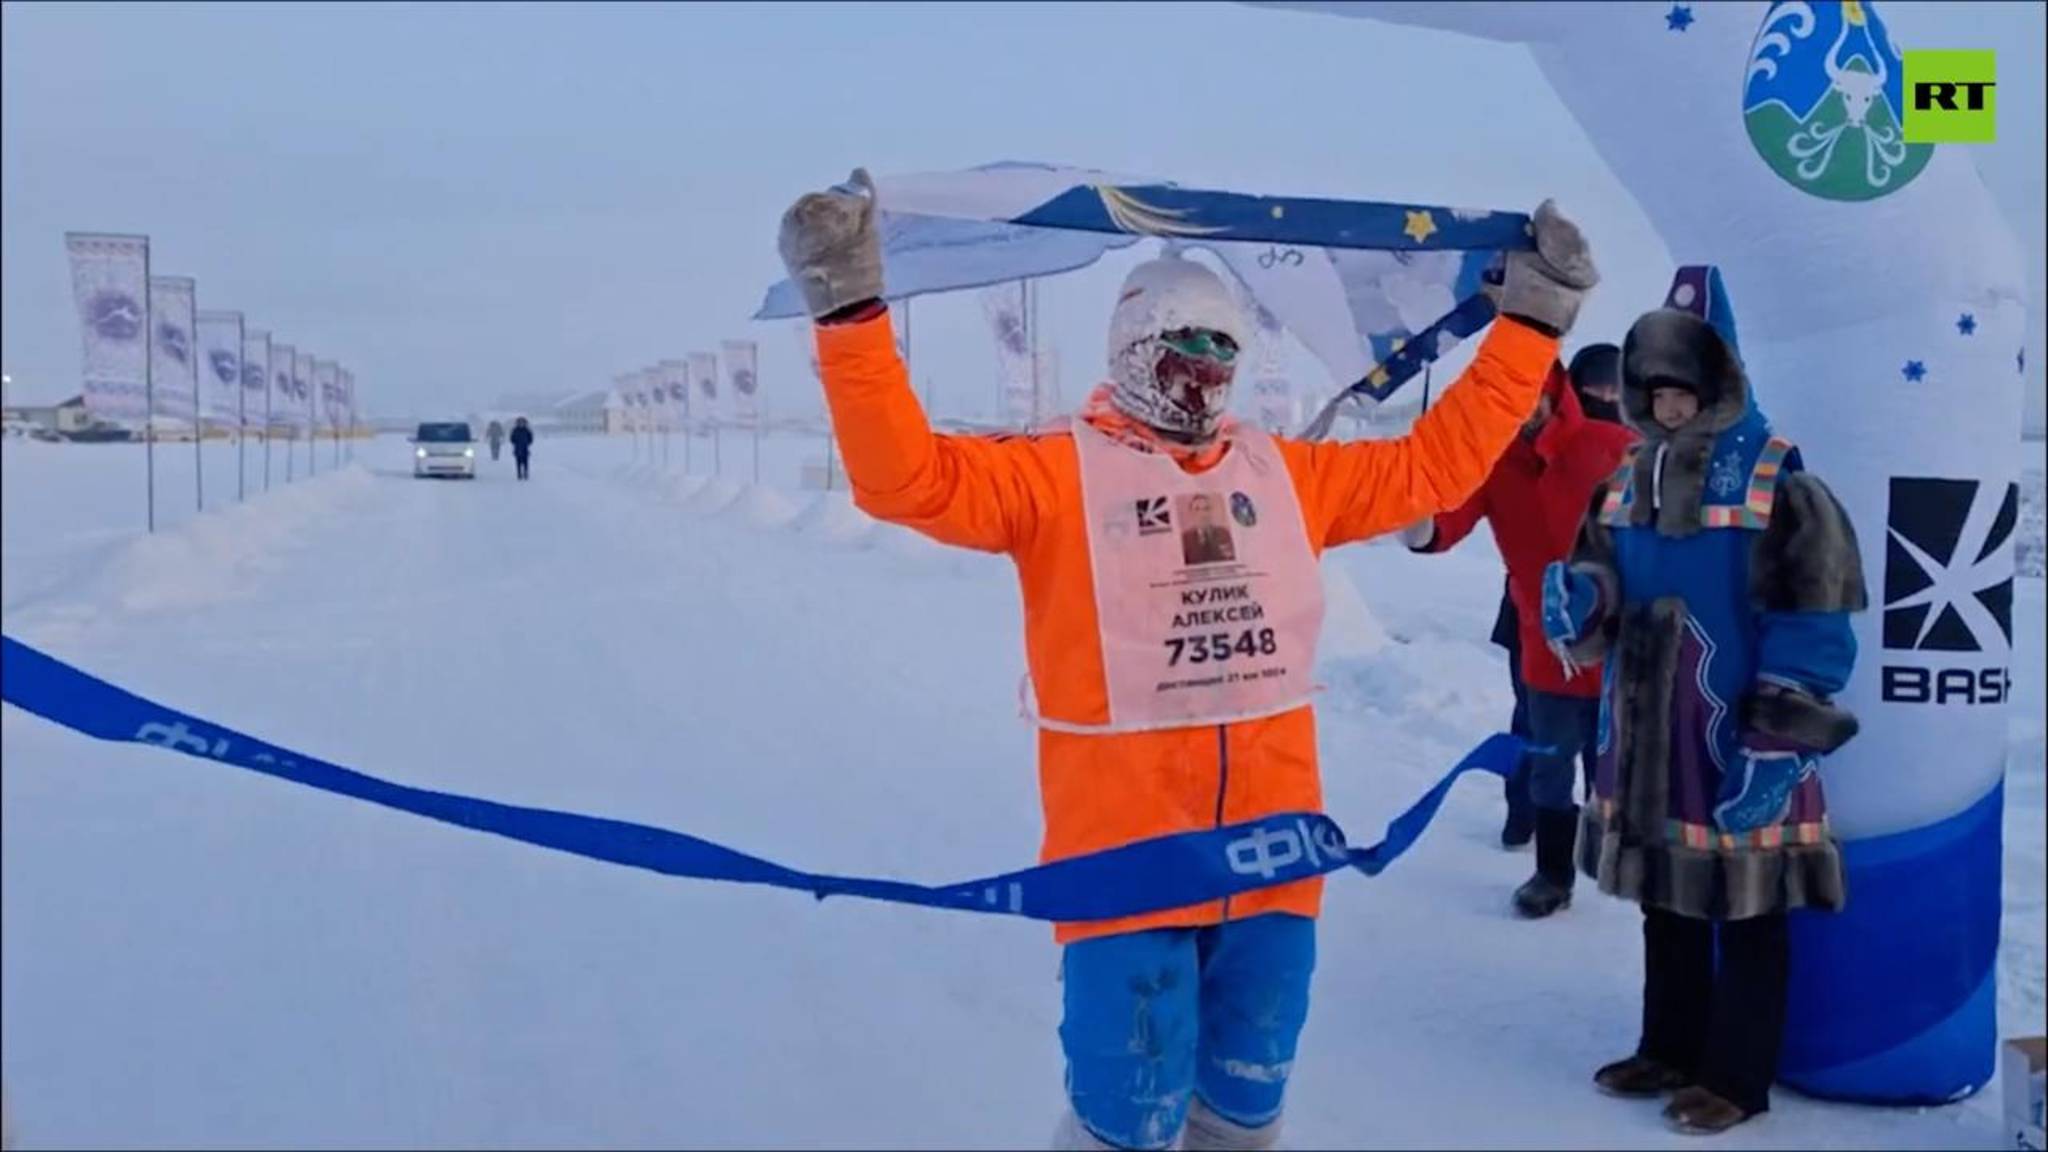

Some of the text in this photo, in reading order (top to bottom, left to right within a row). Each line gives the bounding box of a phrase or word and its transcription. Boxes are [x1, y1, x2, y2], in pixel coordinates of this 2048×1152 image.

[1181, 585, 1249, 605] КУЛИК
[1172, 601, 1264, 629] АЛЕКСЕЙ
[1164, 627, 1277, 668] 73548
